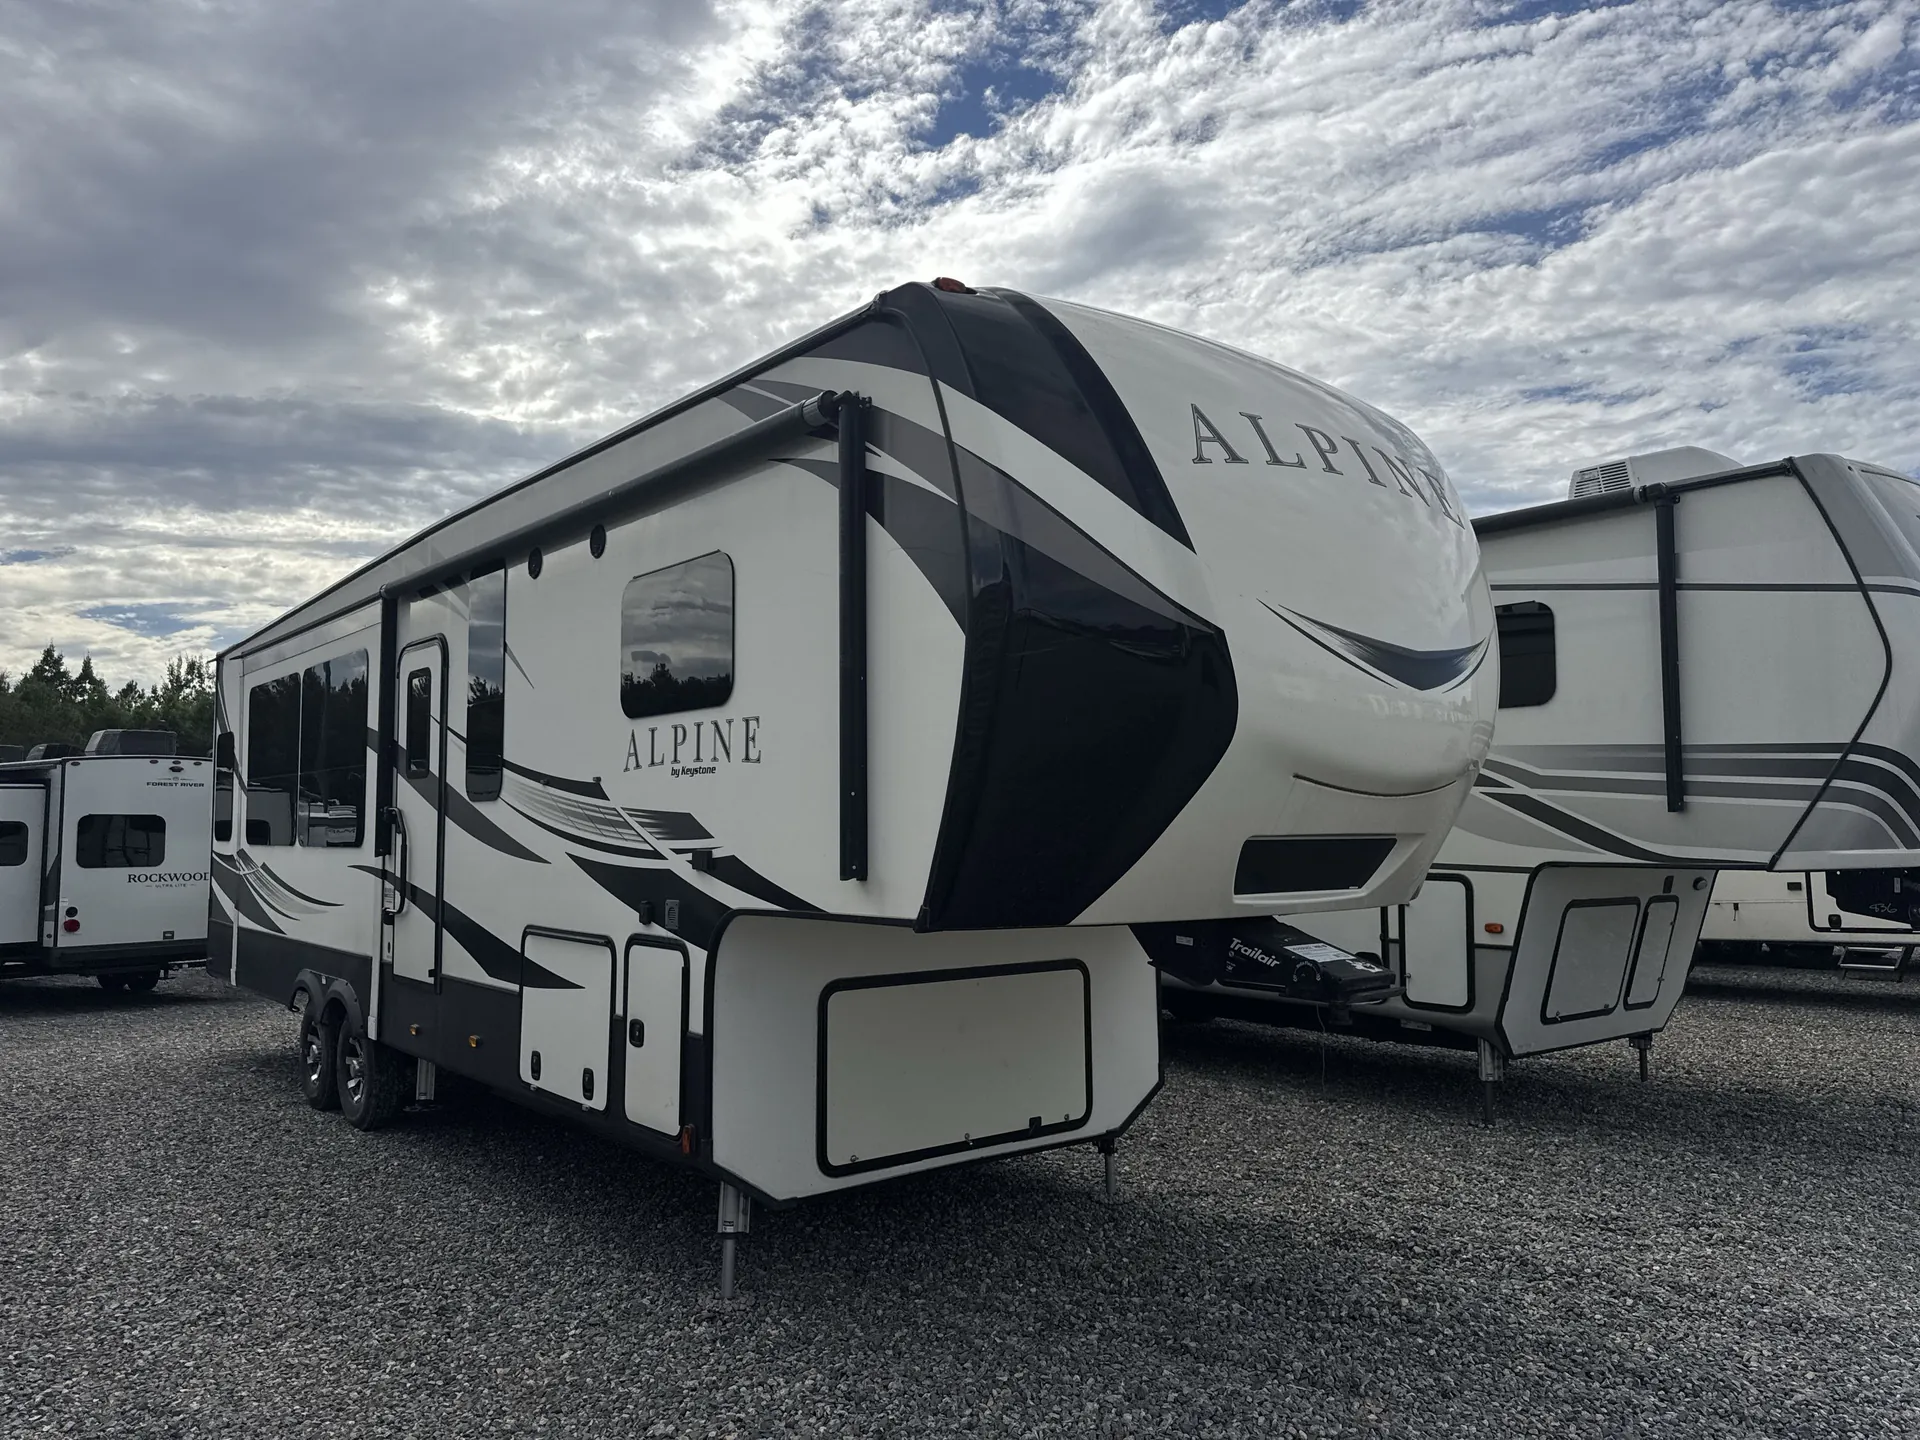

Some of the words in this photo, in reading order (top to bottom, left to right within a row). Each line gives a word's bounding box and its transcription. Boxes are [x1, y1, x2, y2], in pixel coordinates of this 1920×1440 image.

[1190, 403, 1466, 530] ALPINE
[623, 715, 762, 773] ALPINE
[670, 766, 680, 778] by
[680, 765, 717, 778] Keystone
[1229, 937, 1281, 968] Trailair
